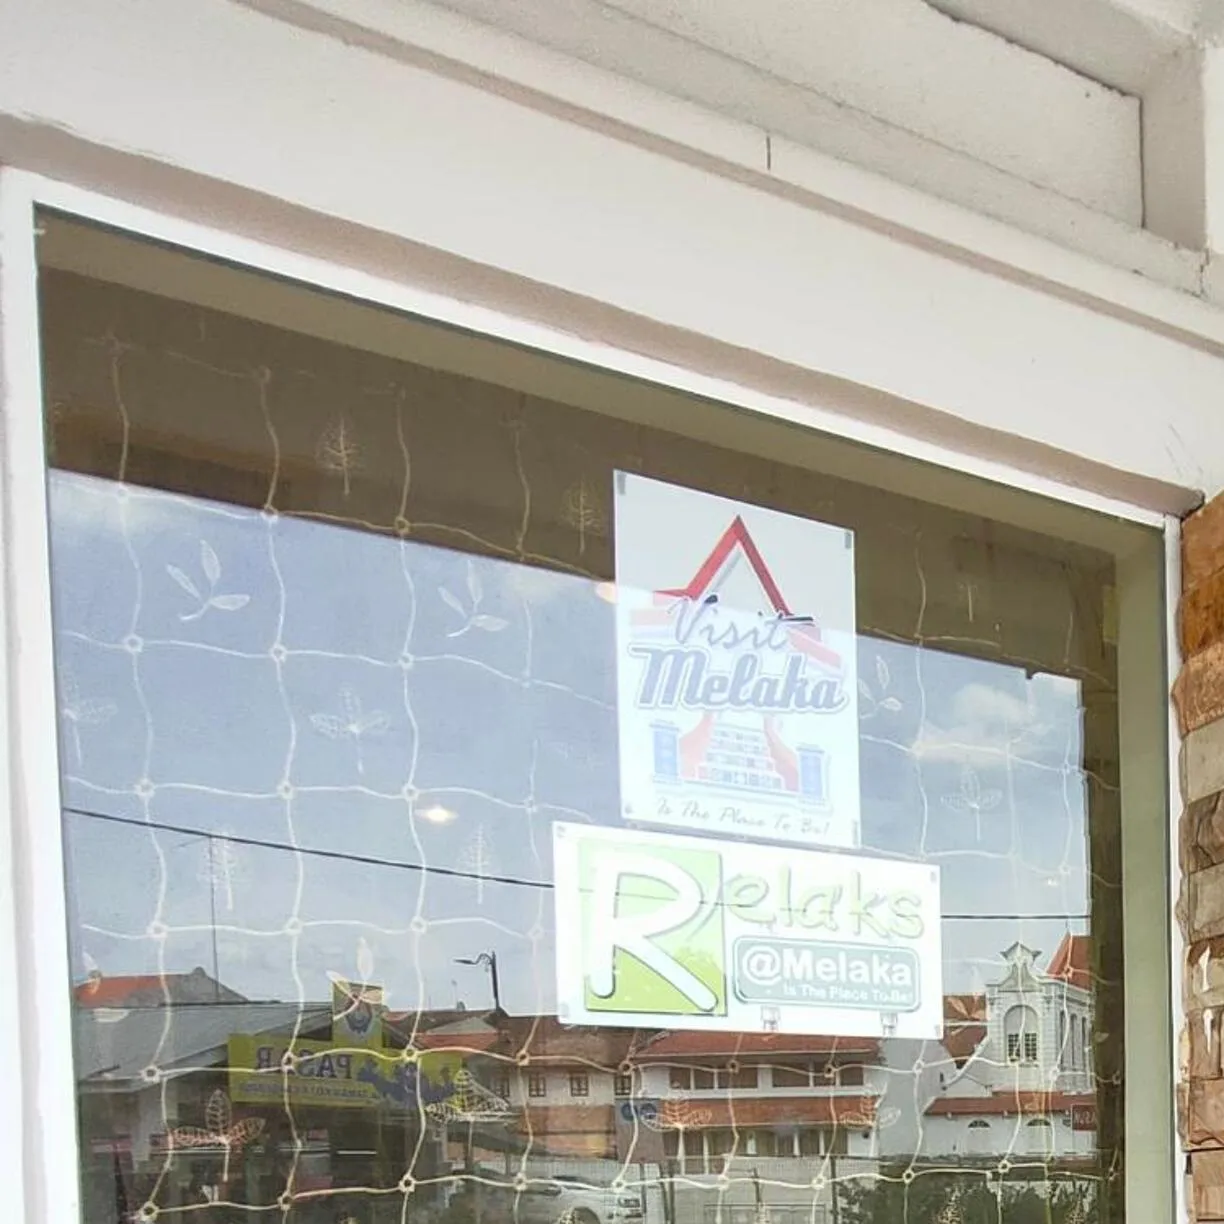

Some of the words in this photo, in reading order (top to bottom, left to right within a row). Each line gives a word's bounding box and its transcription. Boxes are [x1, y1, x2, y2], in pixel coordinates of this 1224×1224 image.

[667, 594, 815, 650] Visit
[630, 646, 846, 710] Melaka
[681, 800, 710, 819] The
[720, 806, 766, 828] Place
[774, 813, 792, 833] To
[586, 846, 925, 1011] Relaks
[741, 944, 912, 986] @Melaka
[799, 984, 826, 998] The
[829, 986, 869, 1002] Place
